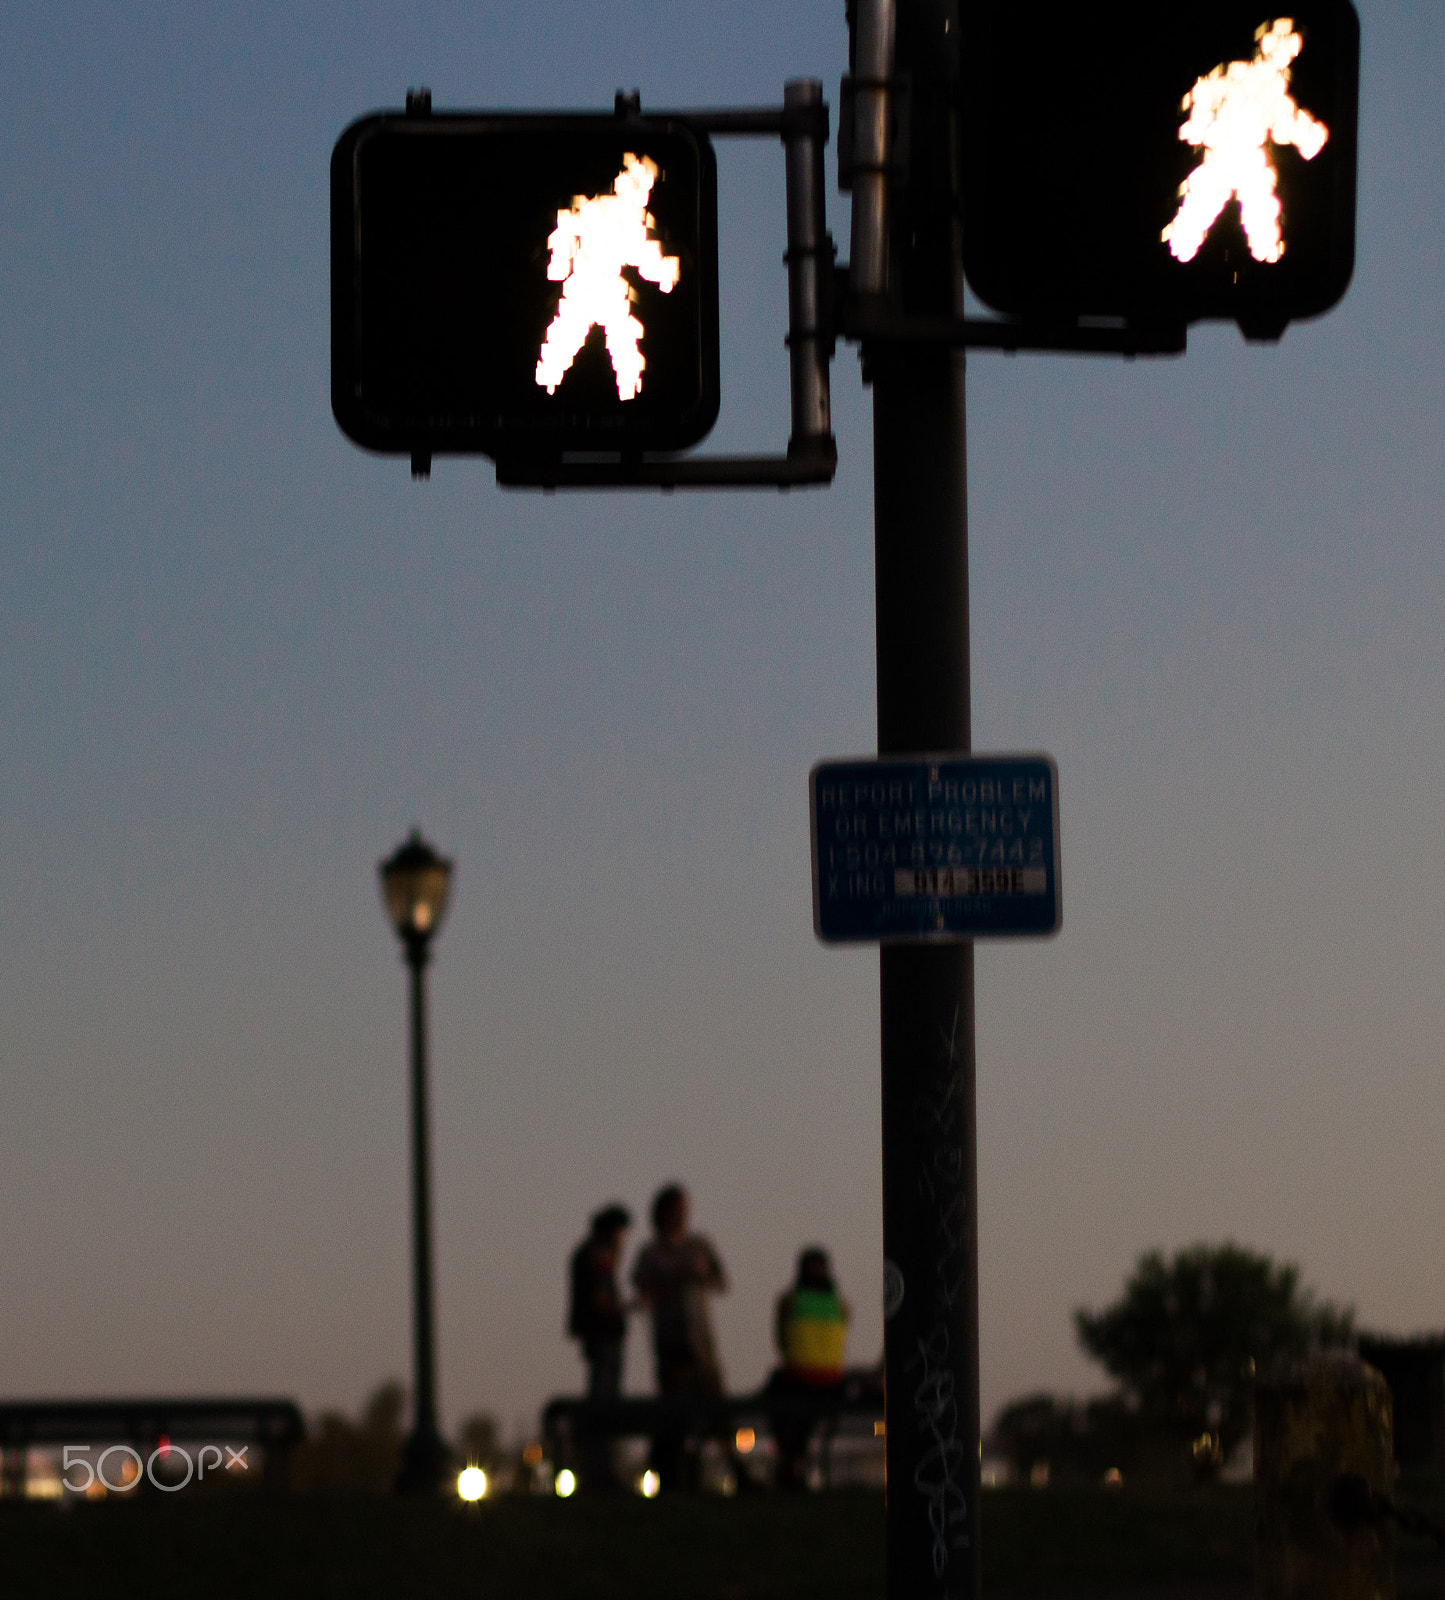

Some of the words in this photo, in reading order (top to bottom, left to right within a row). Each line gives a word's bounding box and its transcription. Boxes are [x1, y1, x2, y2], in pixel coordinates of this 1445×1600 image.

[822, 781, 915, 809] REPORT
[928, 776, 1046, 804] PROBLEM
[835, 811, 867, 839] OR
[879, 808, 1032, 837] EMERGENCY
